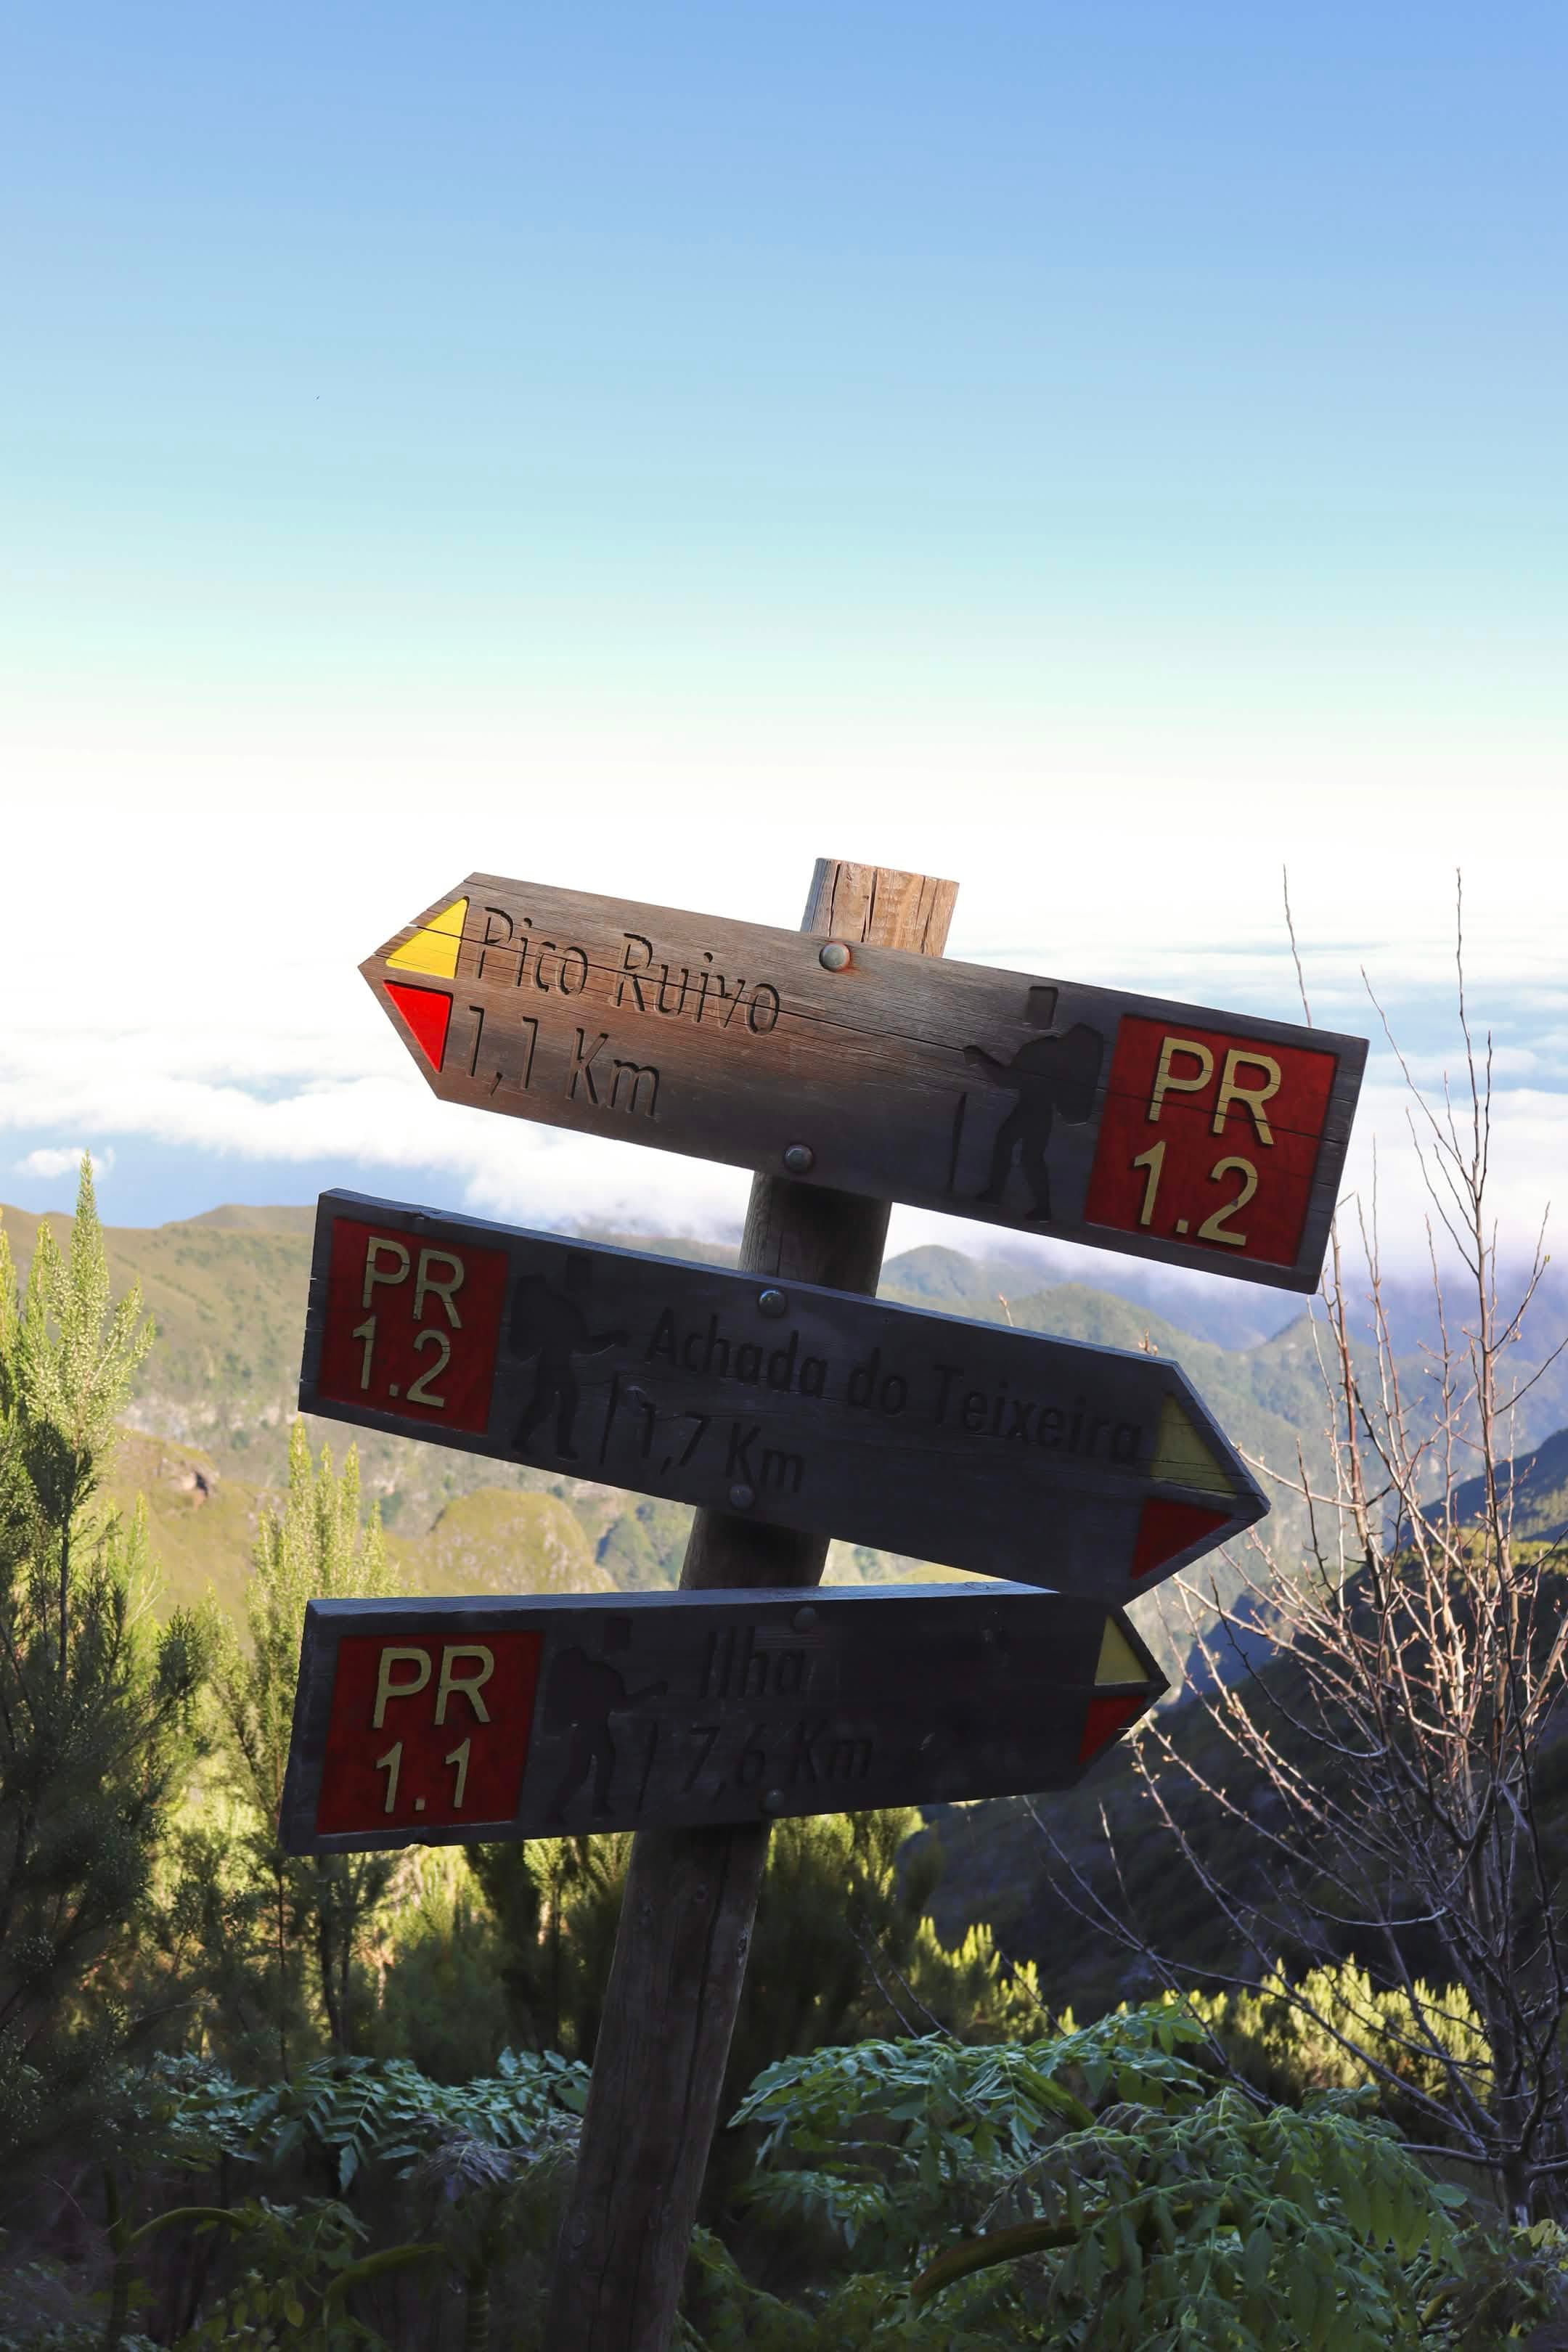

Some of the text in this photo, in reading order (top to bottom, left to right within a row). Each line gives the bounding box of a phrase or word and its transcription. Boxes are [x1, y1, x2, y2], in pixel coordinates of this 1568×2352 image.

[472, 906, 781, 1037] Pico Ruivo
[465, 1005, 661, 1118] 1,1 Km
[1148, 1036, 1282, 1146] PR
[1134, 1140, 1259, 1246] 1.2
[362, 1236, 465, 1329] PR
[351, 1314, 452, 1409] 1.2
[645, 1307, 1143, 1465] Achada do Teixeira
[640, 1402, 806, 1493] 1,7 Km
[372, 1644, 495, 1729] PR
[701, 1625, 805, 1699] Ilha
[375, 1737, 471, 1813] 1.1
[790, 1719, 873, 1784] Km
